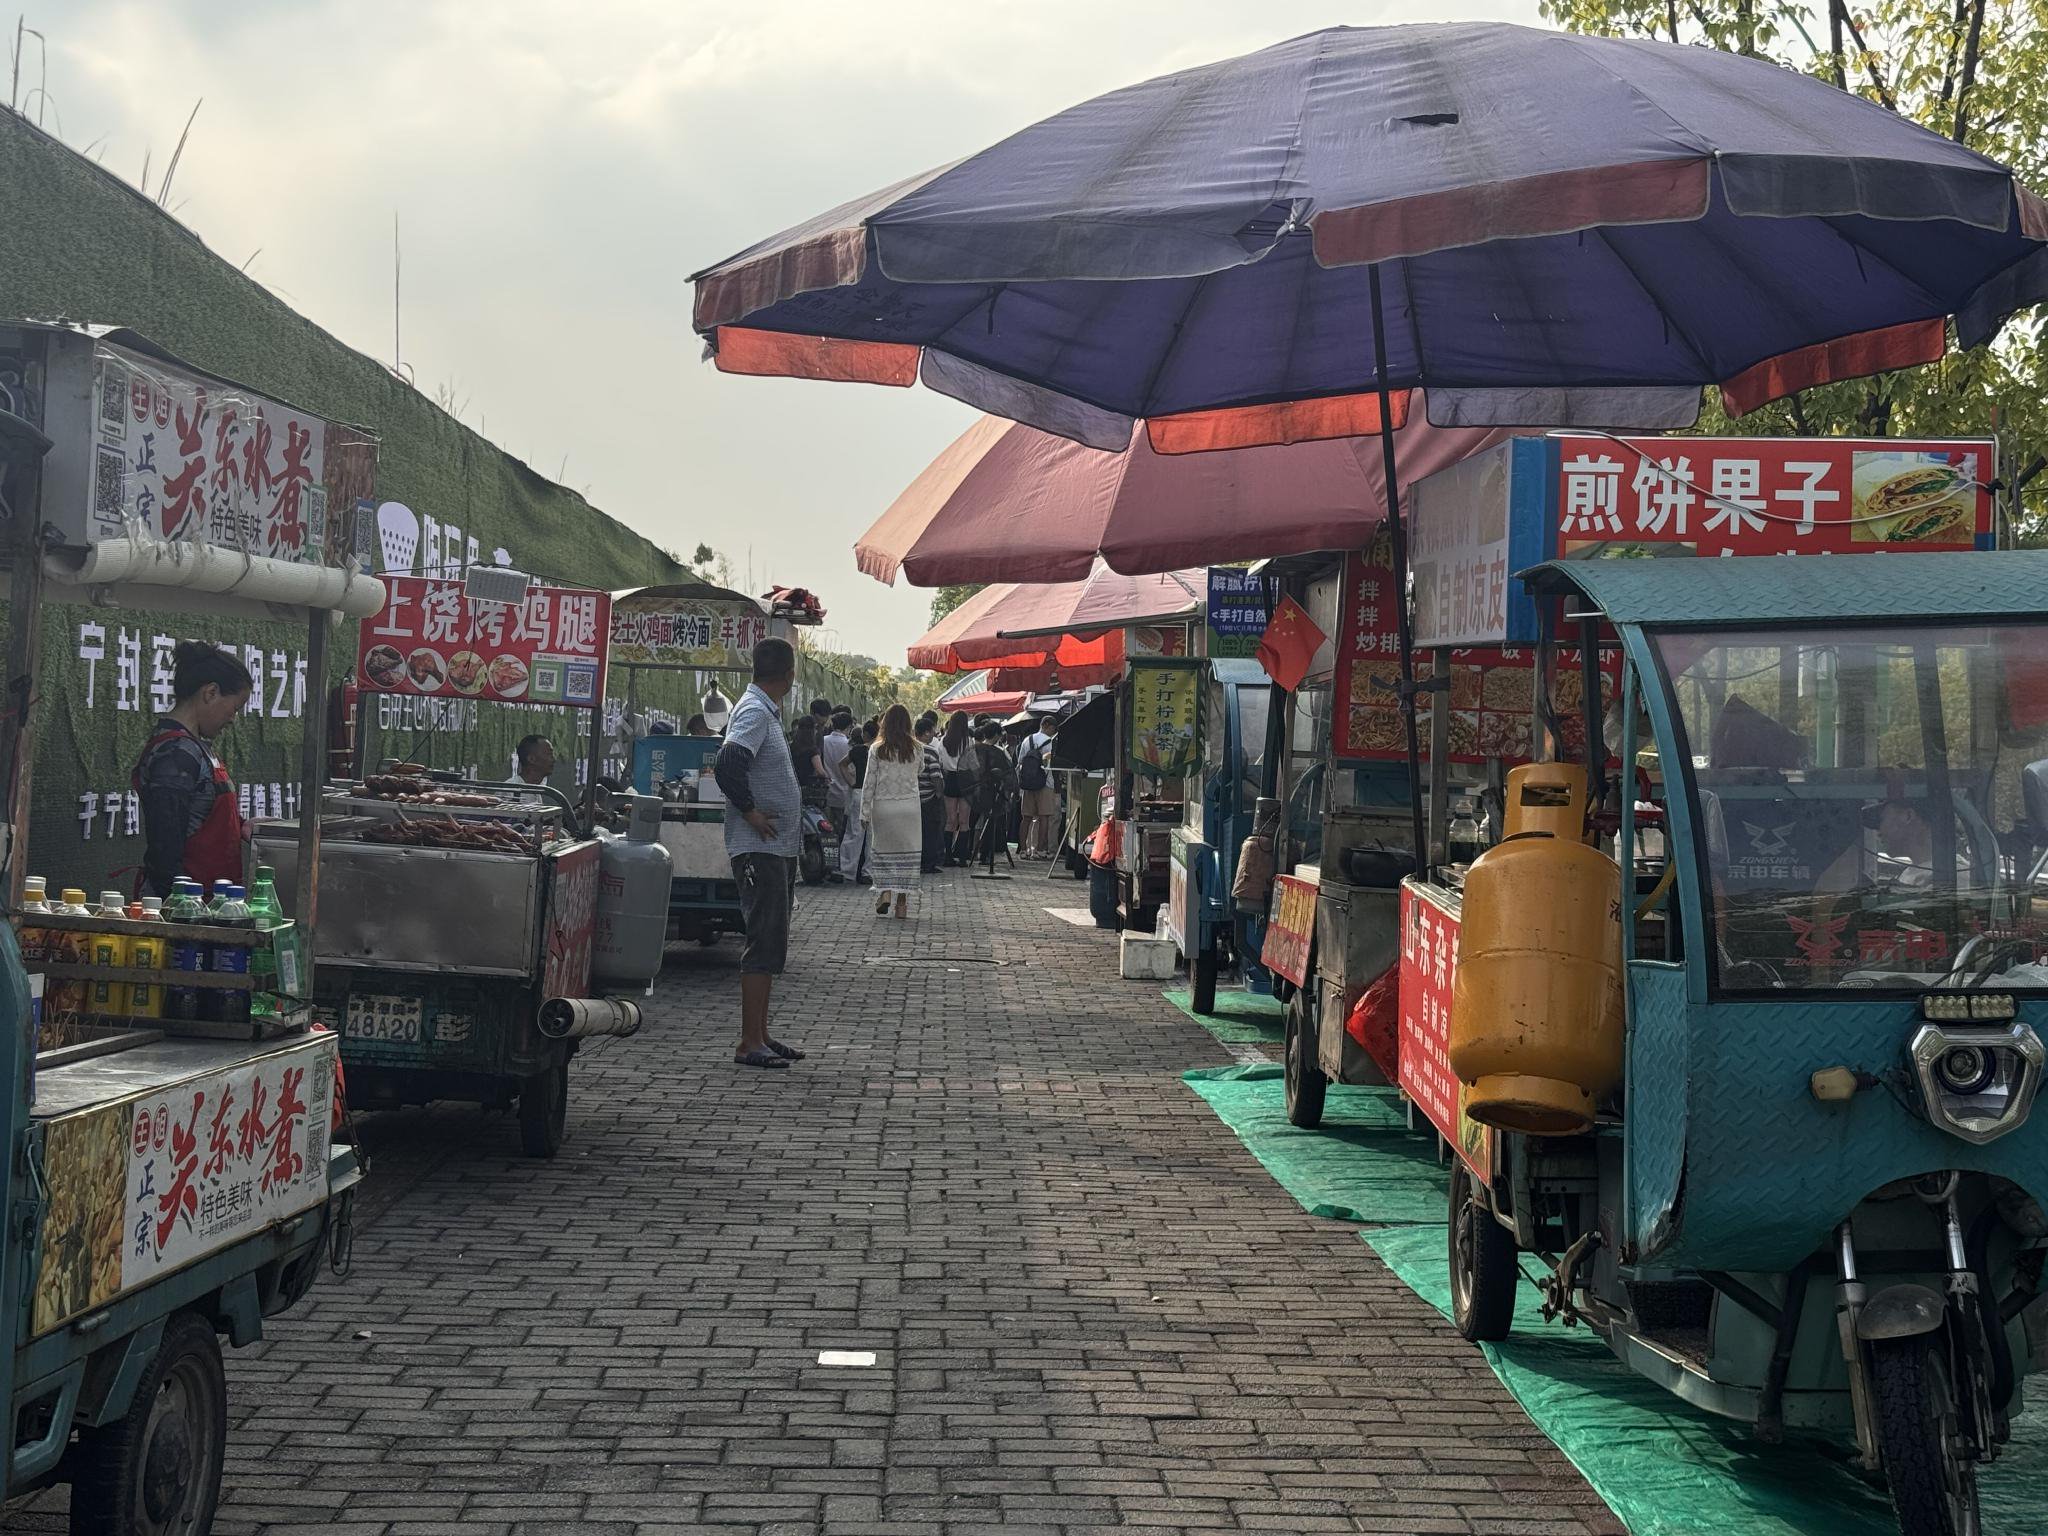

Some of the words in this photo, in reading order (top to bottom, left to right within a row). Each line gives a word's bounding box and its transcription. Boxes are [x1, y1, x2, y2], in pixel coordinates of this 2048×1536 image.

[1560, 454, 1841, 536] 煎饼果子
[210, 504, 262, 549] 特色美味
[1359, 580, 1379, 601] 拌
[1438, 550, 1506, 639] 自制凉皮
[373, 578, 599, 654] 上饶烤鸡腿
[609, 613, 711, 649] 芝士火鸡面烤冷面
[720, 615, 767, 650] 手抓饼
[1358, 605, 1378, 627] 拌
[1155, 672, 1176, 751] 手打柠檬茶
[1727, 864, 1811, 881] 宗申车辆
[1738, 856, 1800, 865] ZONGSHEN
[346, 1014, 418, 1041] 48A20
[134, 1106, 167, 1151] 王姐
[134, 1159, 155, 1257] 正宗
[200, 1176, 253, 1226] 特色美味
